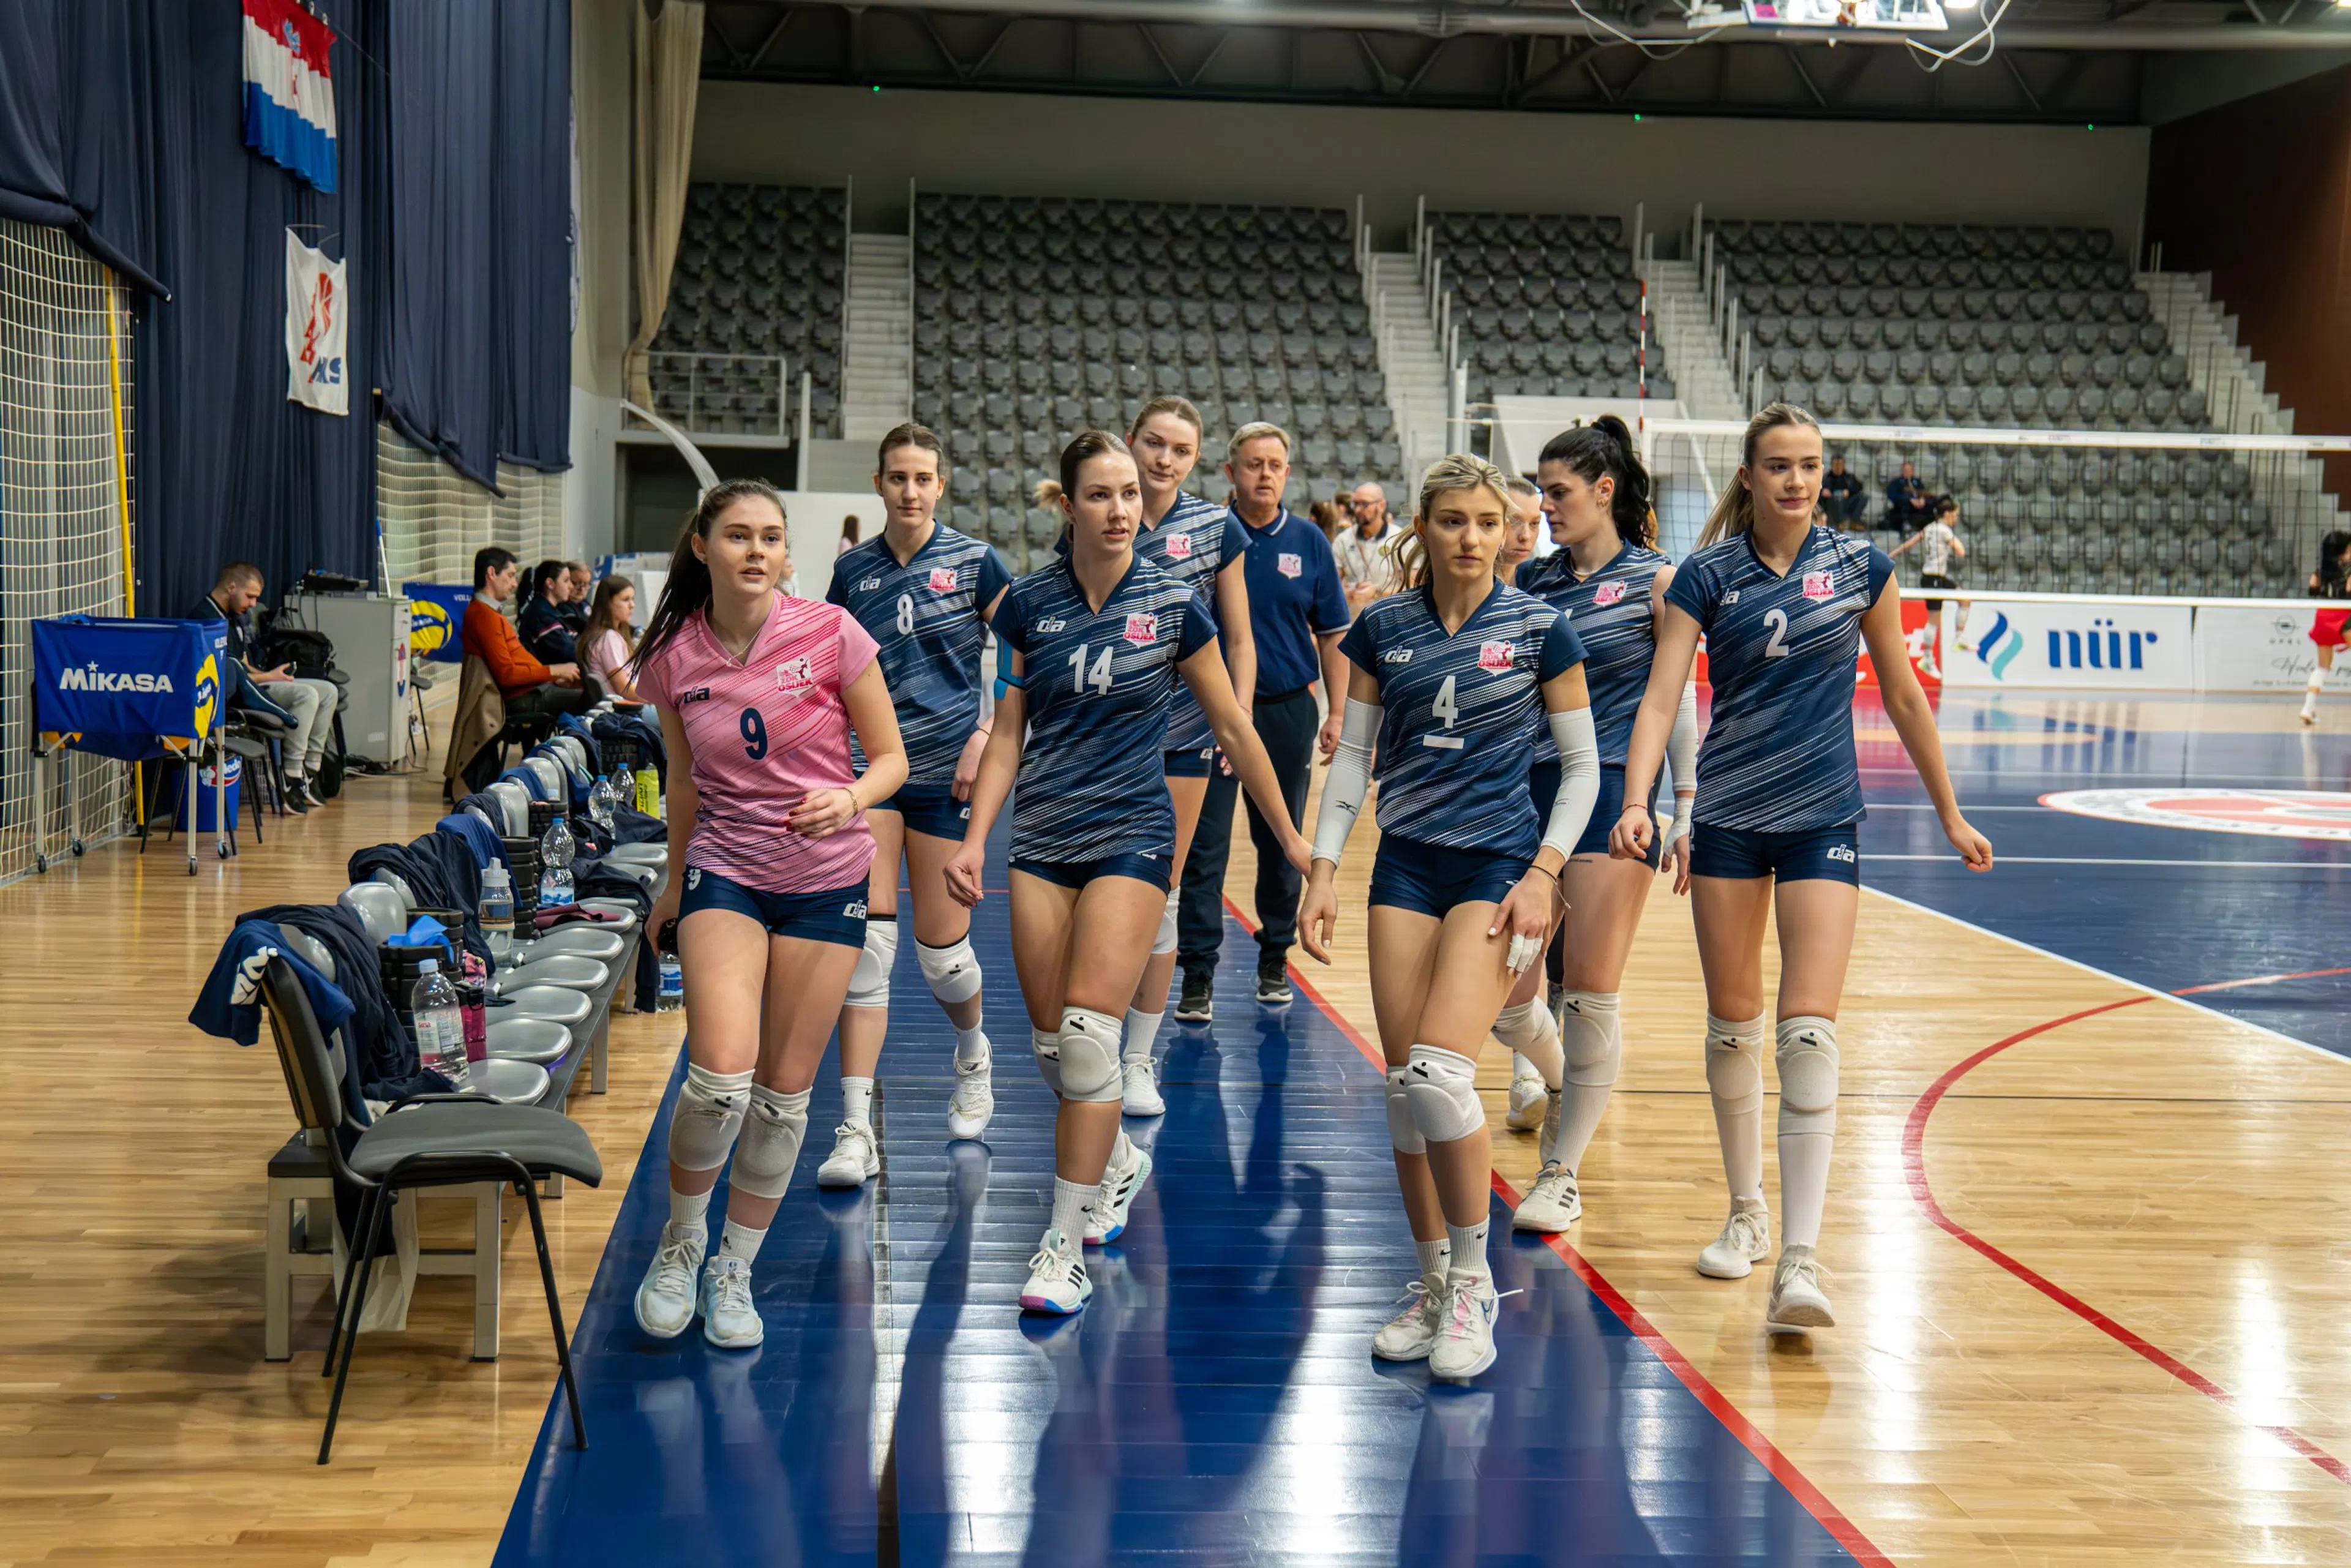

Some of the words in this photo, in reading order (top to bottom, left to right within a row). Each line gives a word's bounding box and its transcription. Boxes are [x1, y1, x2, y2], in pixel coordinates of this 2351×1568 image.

[897, 594, 913, 635] 8
[1123, 632, 1155, 640] OSIJEK
[1763, 609, 1790, 658] 2
[2047, 618, 2158, 669] nür
[778, 678, 813, 691] OSIJEK
[1068, 643, 1114, 696] 14
[1432, 675, 1458, 729] 4
[740, 707, 768, 760] 9
